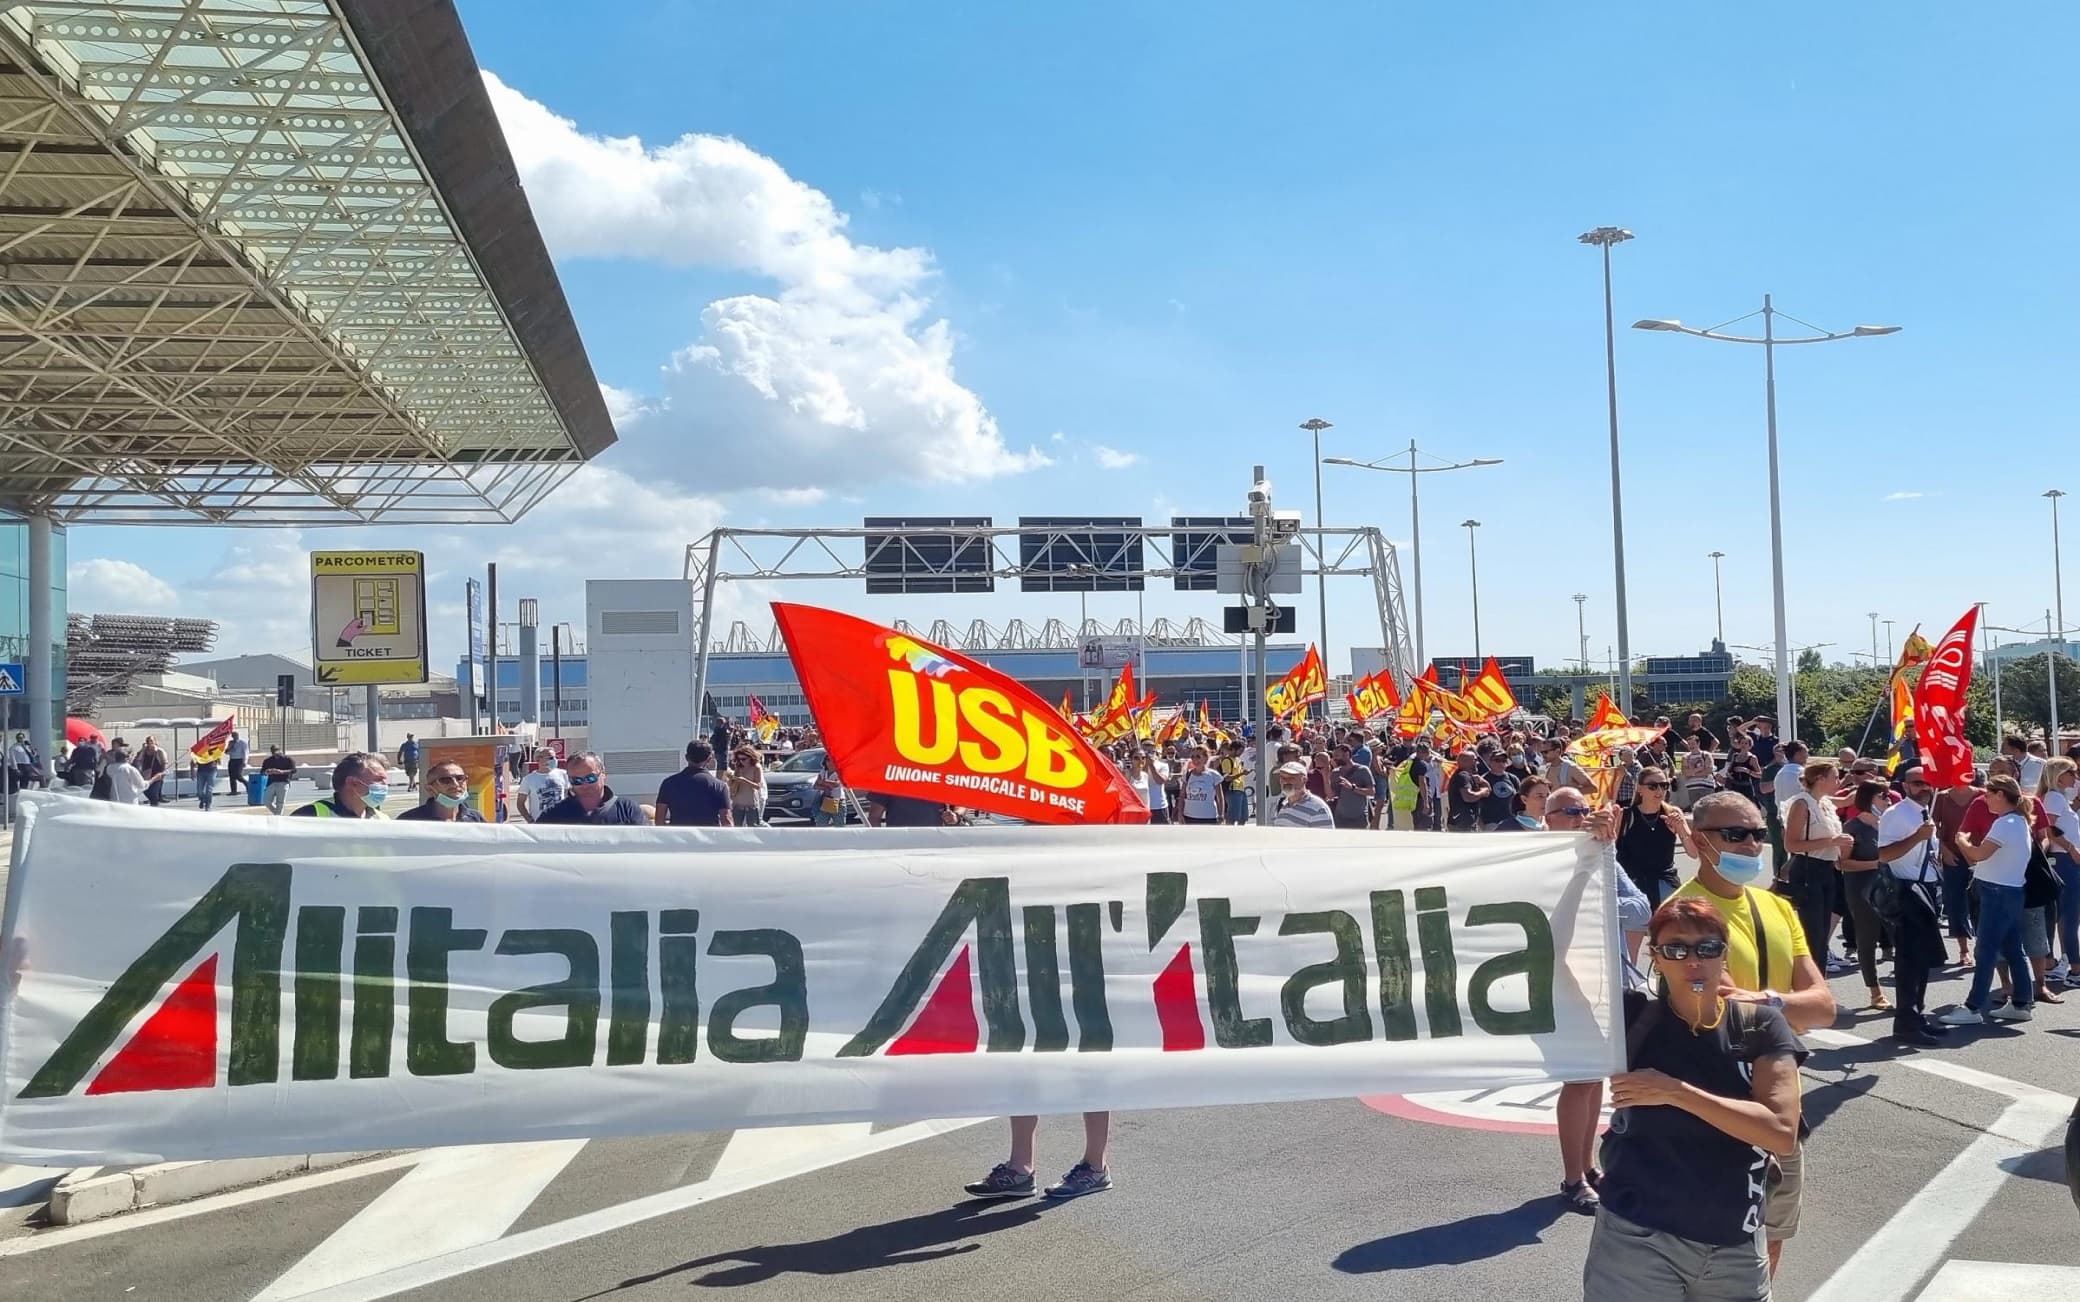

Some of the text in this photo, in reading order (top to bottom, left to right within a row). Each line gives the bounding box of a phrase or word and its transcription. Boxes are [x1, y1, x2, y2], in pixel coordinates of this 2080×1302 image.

[315, 556, 416, 567] PARCOMETRO
[345, 648, 392, 657] TICKET
[888, 669, 1088, 789] USB
[884, 765, 1085, 815] UNIONE SINDACALE DI BASE
[17, 863, 809, 1098] Alitalia
